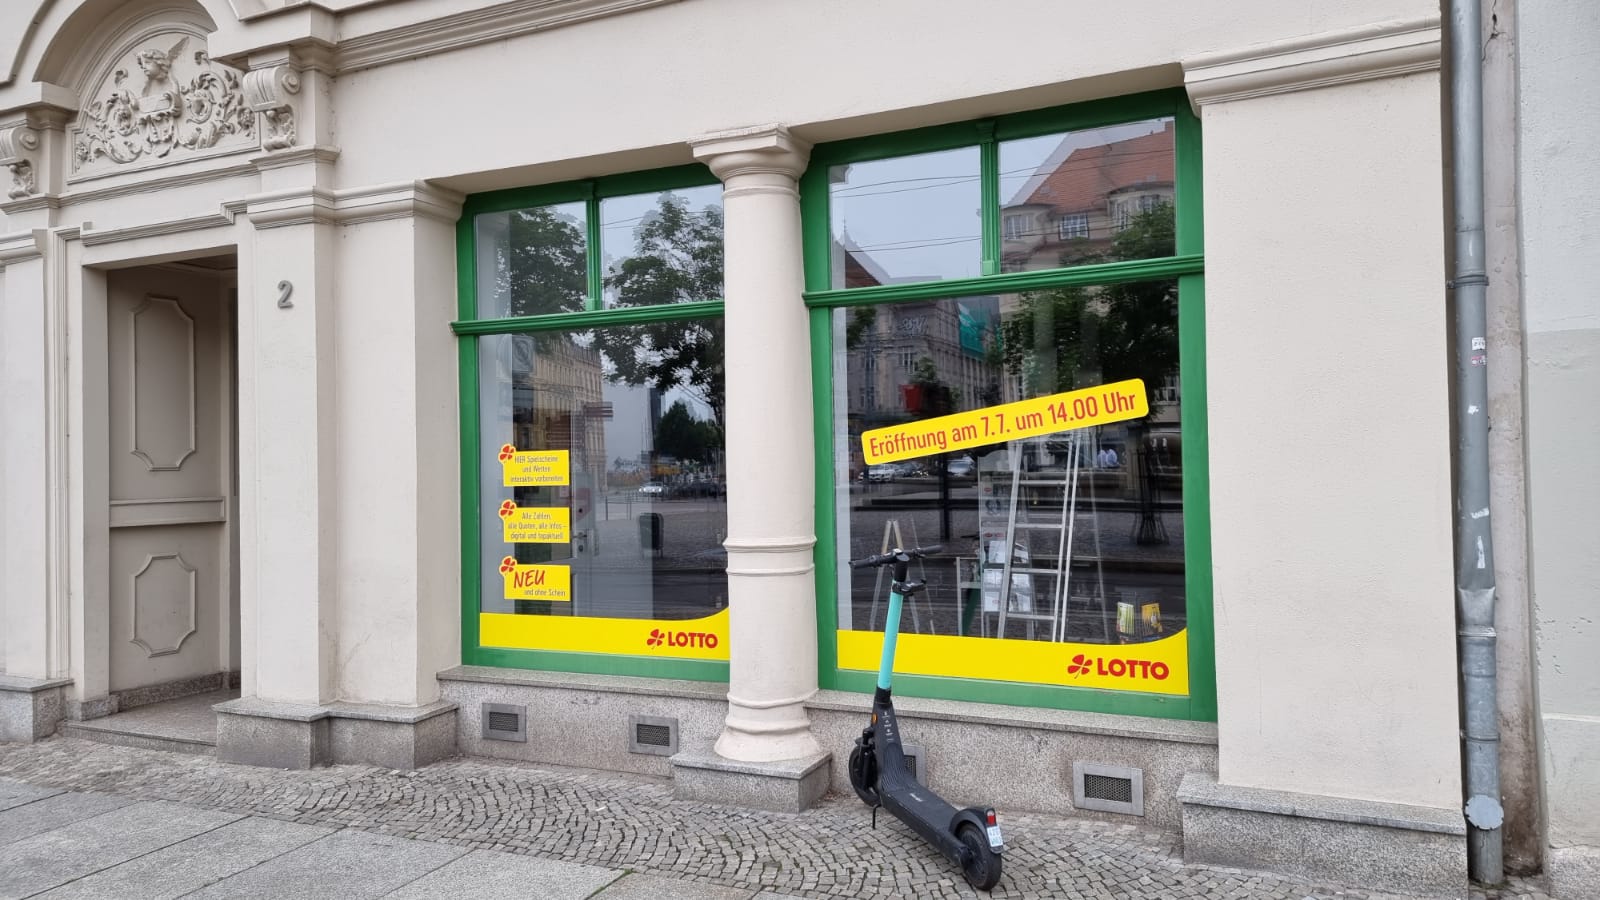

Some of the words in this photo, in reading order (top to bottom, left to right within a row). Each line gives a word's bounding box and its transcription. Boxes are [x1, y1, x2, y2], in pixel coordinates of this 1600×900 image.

[277, 280, 294, 310] 2
[869, 429, 948, 457] Eröffnung
[952, 422, 978, 442] am
[980, 414, 1011, 437] 7.7.
[1015, 411, 1044, 431] um
[1047, 396, 1099, 425] 14.00
[1102, 391, 1137, 415] Uhr
[522, 512, 532, 520] Alle
[528, 532, 537, 540] und
[513, 569, 546, 589] NEU
[524, 588, 534, 596] und
[535, 589, 547, 597] ohne
[548, 589, 566, 598] Schein
[667, 631, 719, 649] LOTTO
[1097, 657, 1170, 681] LOTTO
